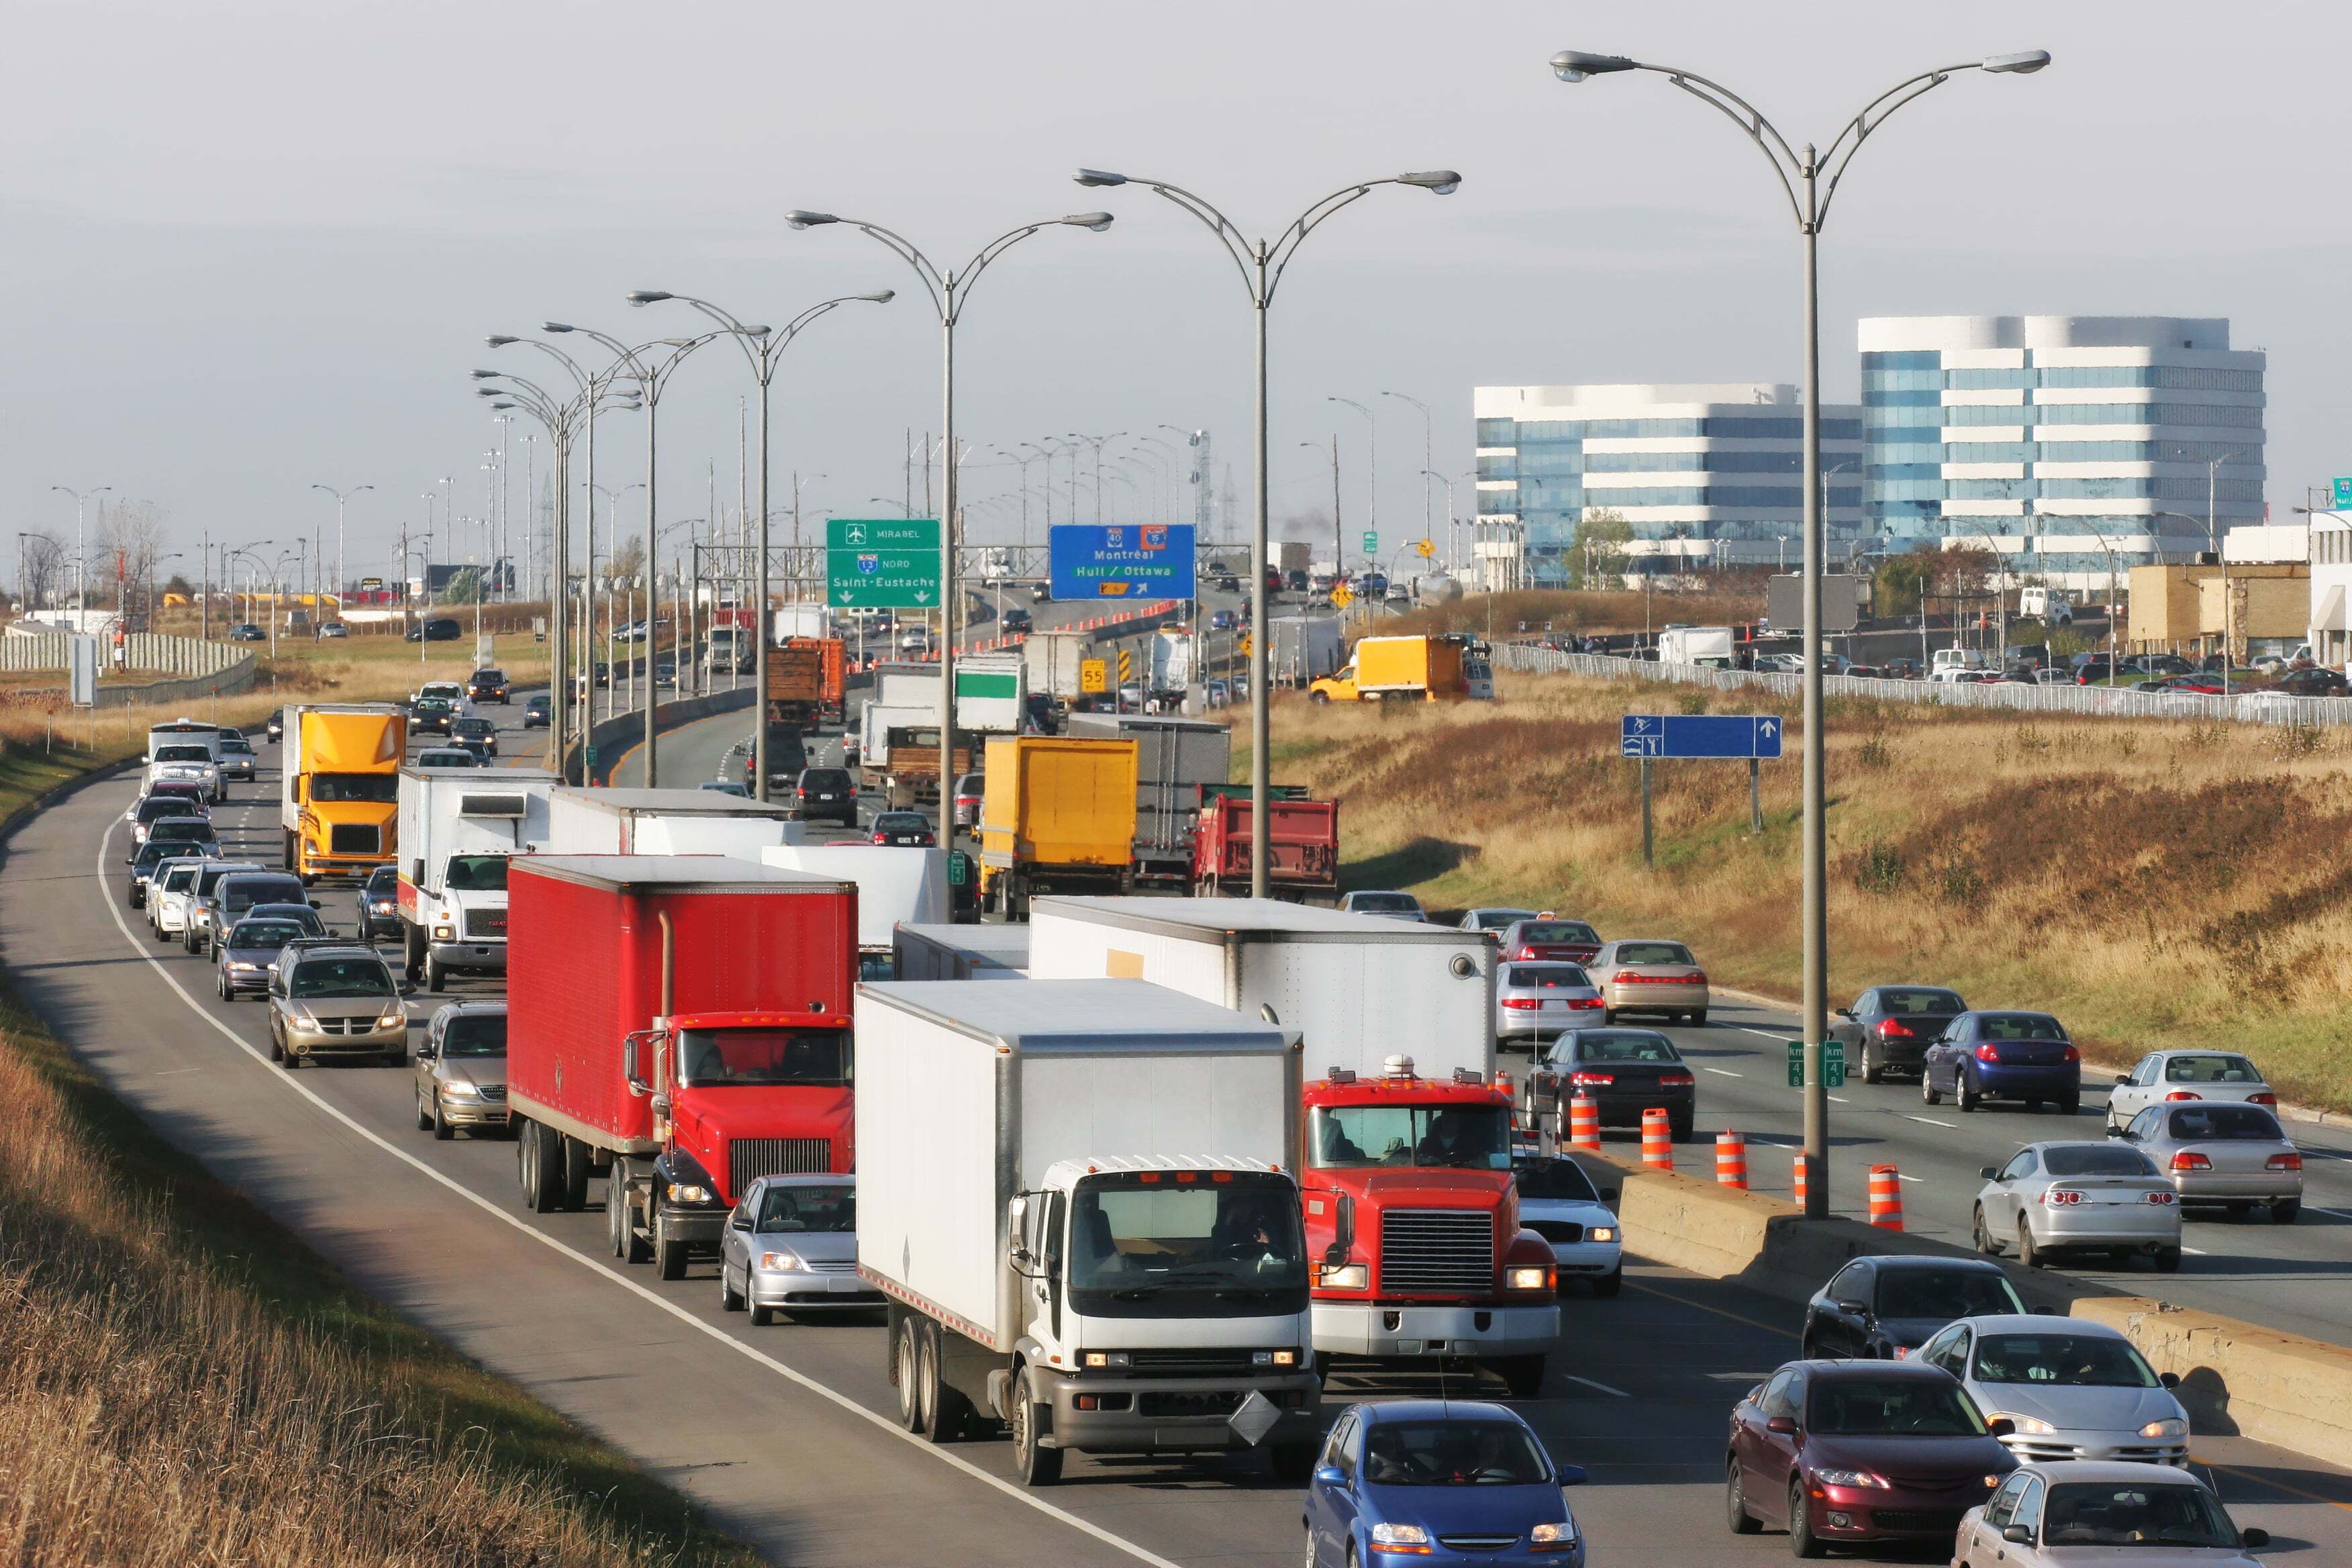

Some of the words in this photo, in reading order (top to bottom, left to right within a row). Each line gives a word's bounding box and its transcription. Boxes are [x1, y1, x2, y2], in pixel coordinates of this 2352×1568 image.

[862, 560, 873, 569] 13
[883, 560, 910, 569] NORD
[1077, 566, 1105, 577] Hull
[1124, 566, 1171, 576] Ottawa
[1084, 670, 1102, 683] 55
[1790, 1047, 1804, 1056] km
[1827, 1047, 1843, 1056] km
